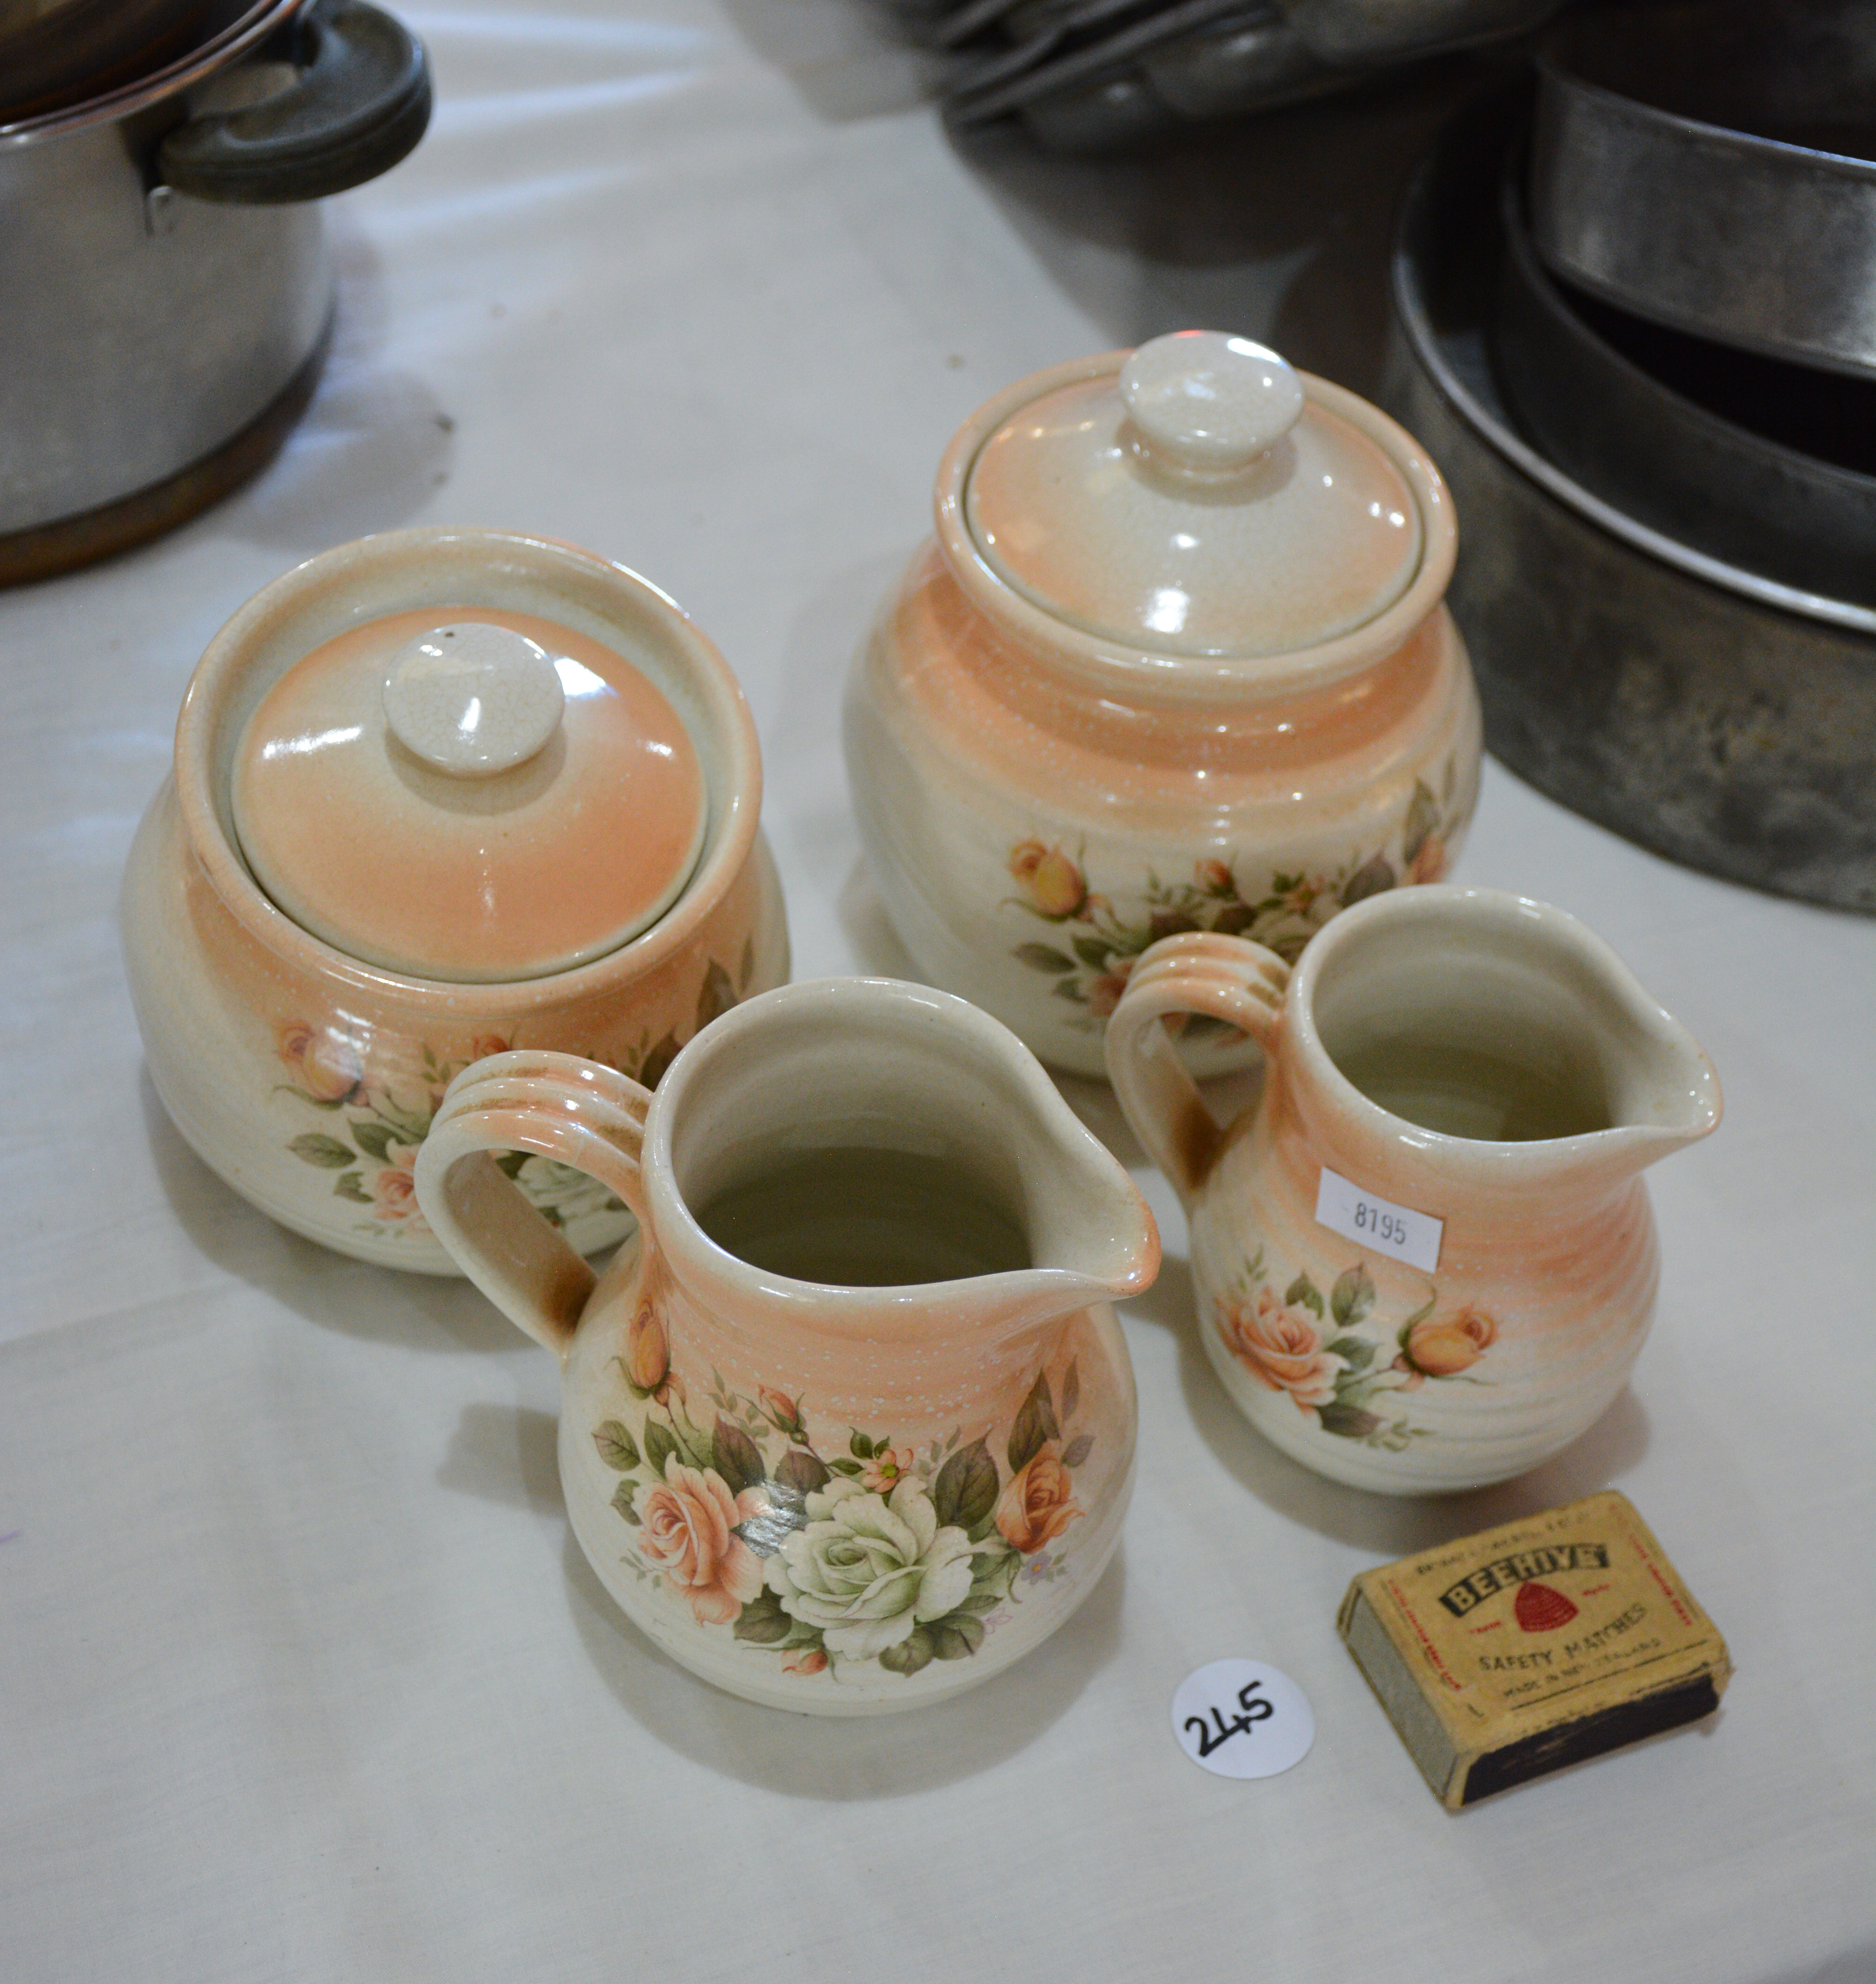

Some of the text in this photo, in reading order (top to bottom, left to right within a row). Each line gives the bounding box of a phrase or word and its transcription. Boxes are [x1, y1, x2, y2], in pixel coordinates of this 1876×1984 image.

[1354, 1202, 1406, 1245] 8195
[1444, 1544, 1604, 1614] BEEHIVE
[1479, 1601, 1647, 1671] SAFETY MATCHES
[1184, 1679, 1274, 1757] 245
[1503, 1681, 1539, 1697] MADE
